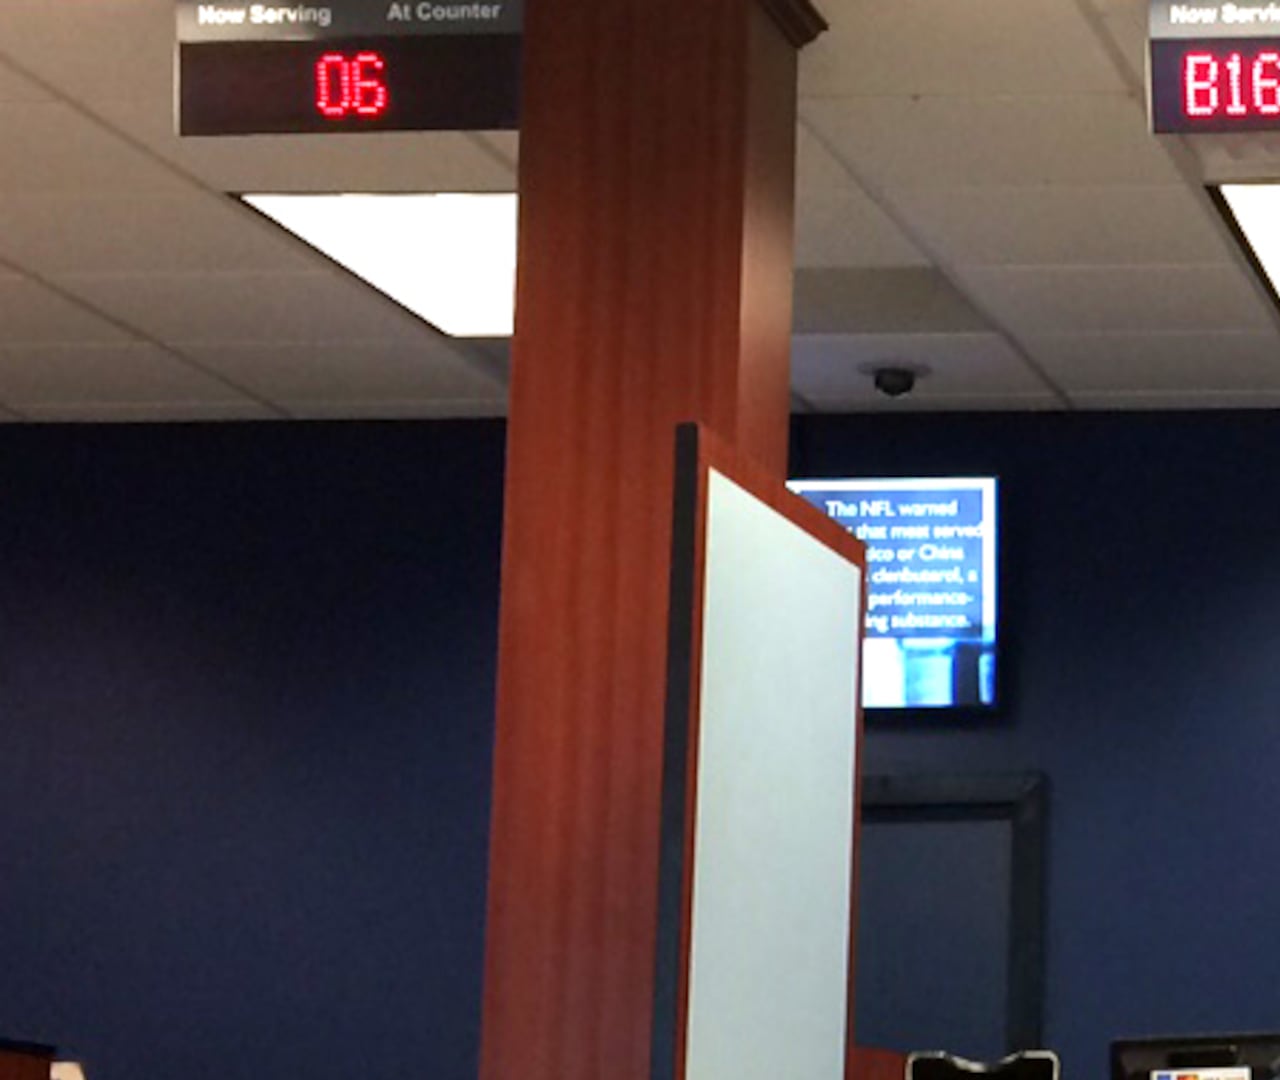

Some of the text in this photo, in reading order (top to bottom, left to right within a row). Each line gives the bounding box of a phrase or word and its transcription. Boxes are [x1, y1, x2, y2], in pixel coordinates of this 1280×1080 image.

[197, 5, 333, 26] Now Serving
[387, 2, 501, 21] At Counter
[1169, 5, 1217, 24] Now
[315, 53, 387, 116] 06
[825, 499, 958, 517] The NFL warned
[856, 523, 887, 540] that
[897, 548, 915, 562] or
[918, 543, 965, 562] China
